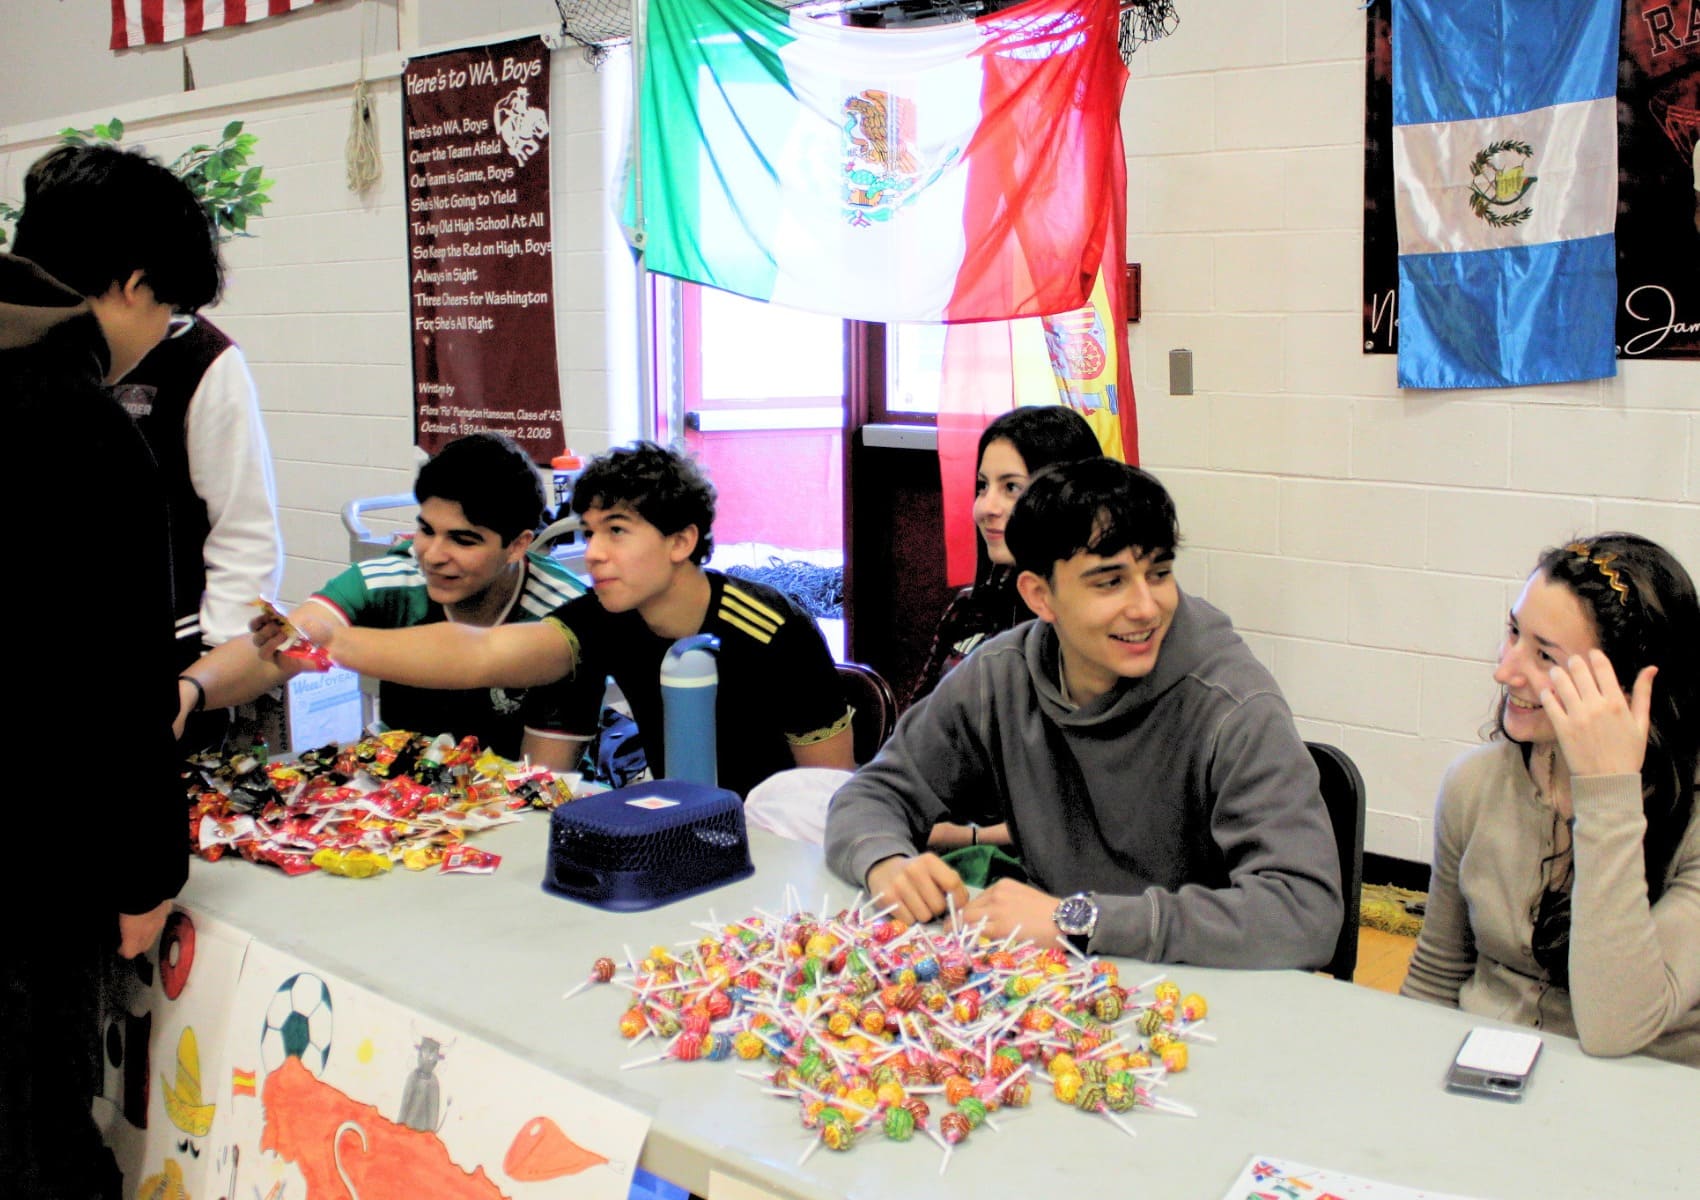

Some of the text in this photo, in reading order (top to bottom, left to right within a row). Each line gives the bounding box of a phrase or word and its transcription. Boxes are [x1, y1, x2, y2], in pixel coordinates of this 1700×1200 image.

[407, 57, 541, 96] Here's to WA, Boys
[408, 118, 488, 140] Here's to WA, Boys
[410, 140, 501, 164] Cheer the Team Afield
[410, 165, 514, 188] Our Team is Game, Boys
[411, 189, 517, 212] She's Not Going to Yield
[412, 212, 544, 237] To Any Old High School At All
[413, 239, 552, 262] So Keep the Red on High, Boys
[414, 267, 478, 285] Always in Sight
[414, 290, 548, 308] Three Cheers for Washington
[415, 316, 494, 334] For She's All Right
[418, 383, 455, 397] Written by
[517, 409, 537, 421] Class
[538, 410, 547, 421] of
[421, 421, 450, 433] October
[517, 427, 525, 439] 2,
[527, 427, 552, 439] 2008
